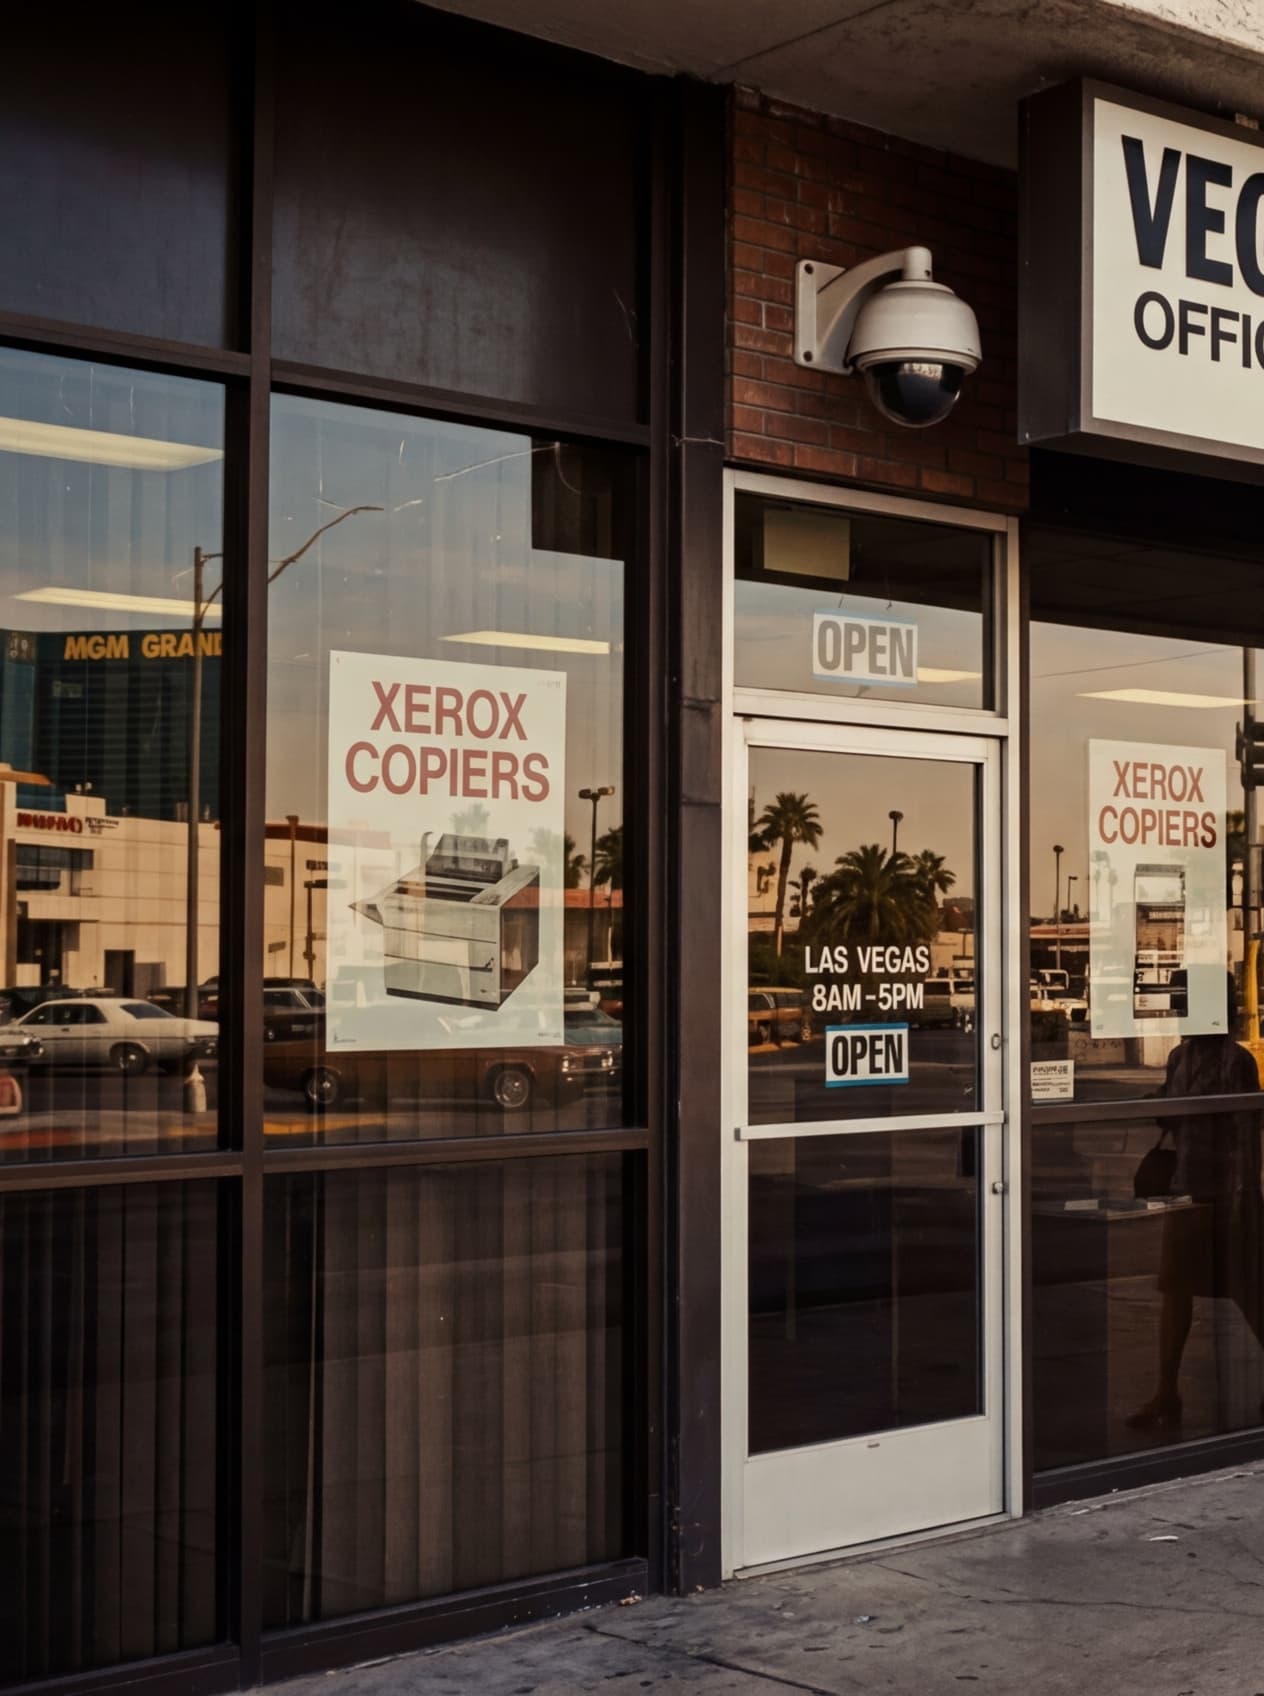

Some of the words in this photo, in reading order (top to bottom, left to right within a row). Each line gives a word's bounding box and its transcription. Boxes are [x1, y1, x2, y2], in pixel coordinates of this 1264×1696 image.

[64, 633, 130, 660] MGM
[817, 619, 915, 678] OPEN
[370, 680, 528, 741] XEROX
[344, 741, 550, 802] COPIERS
[1112, 760, 1204, 803] XEROX
[1099, 805, 1217, 848] COPIERS
[804, 945, 849, 974] LAS
[857, 945, 930, 974] VEGAS
[831, 1033, 903, 1076] OPEN
